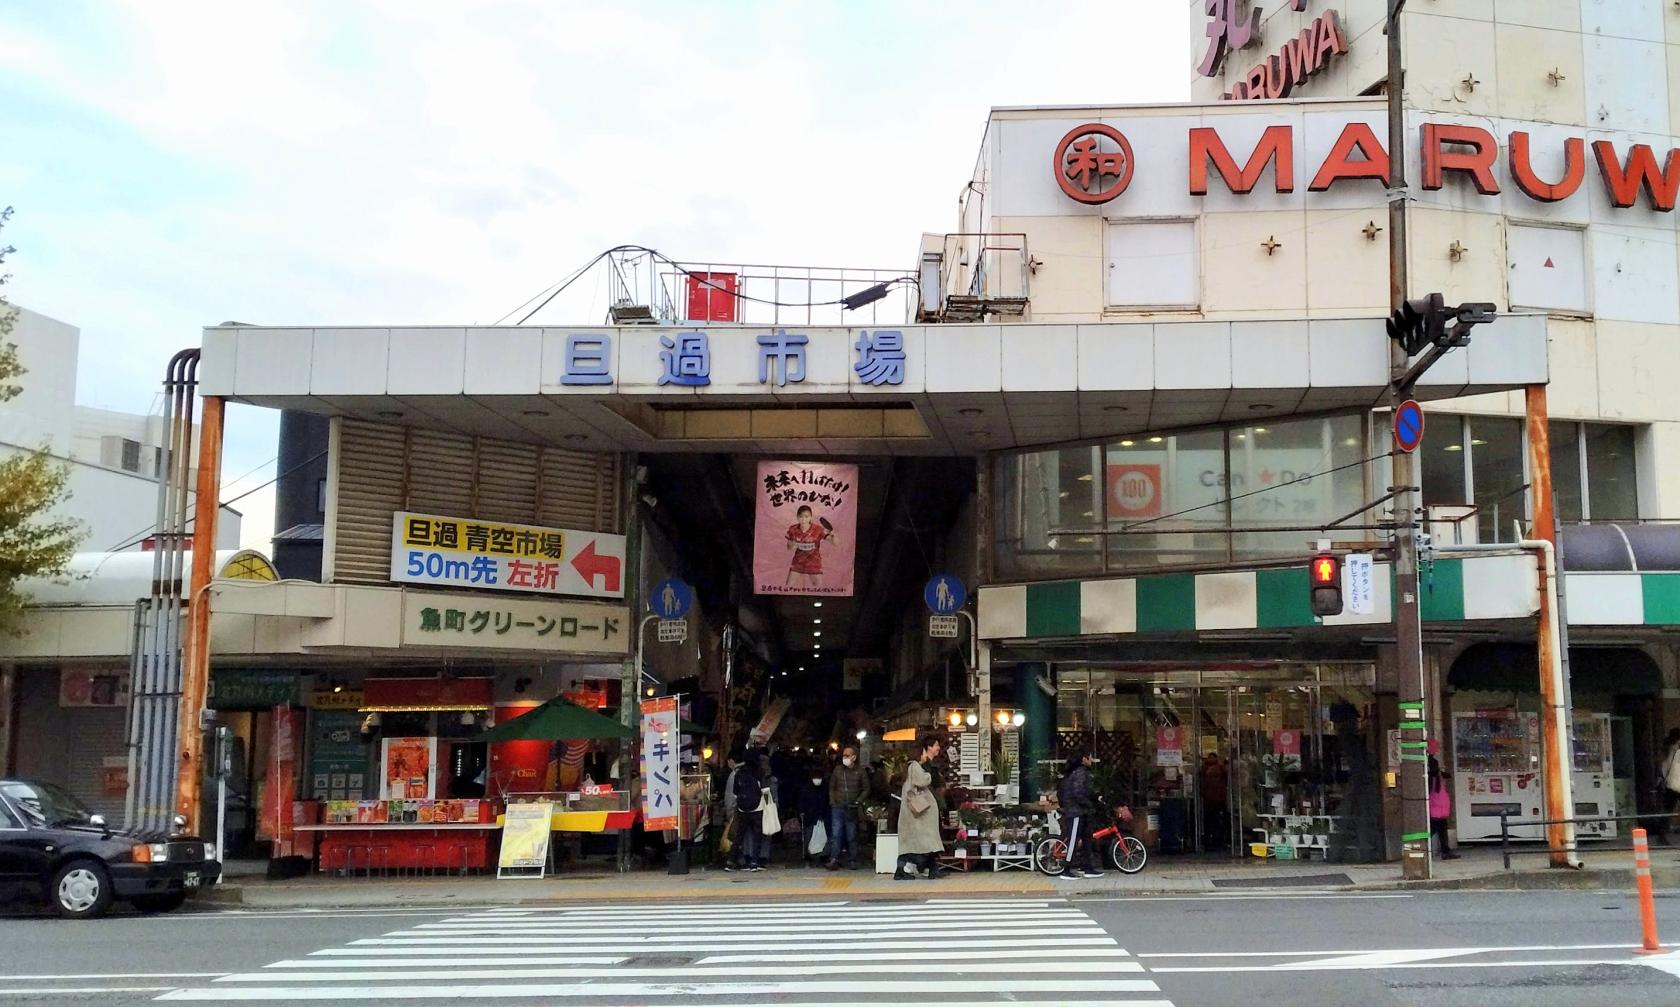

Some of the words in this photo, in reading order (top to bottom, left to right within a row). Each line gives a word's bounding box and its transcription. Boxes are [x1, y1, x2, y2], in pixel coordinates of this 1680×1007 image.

[560, 329, 906, 387] 旦過市場
[406, 519, 459, 549] 旦過
[465, 524, 562, 560] 青空市場
[407, 551, 498, 585] 50m先
[506, 560, 560, 590] 左折
[419, 607, 619, 640] 魚町グリーンロード
